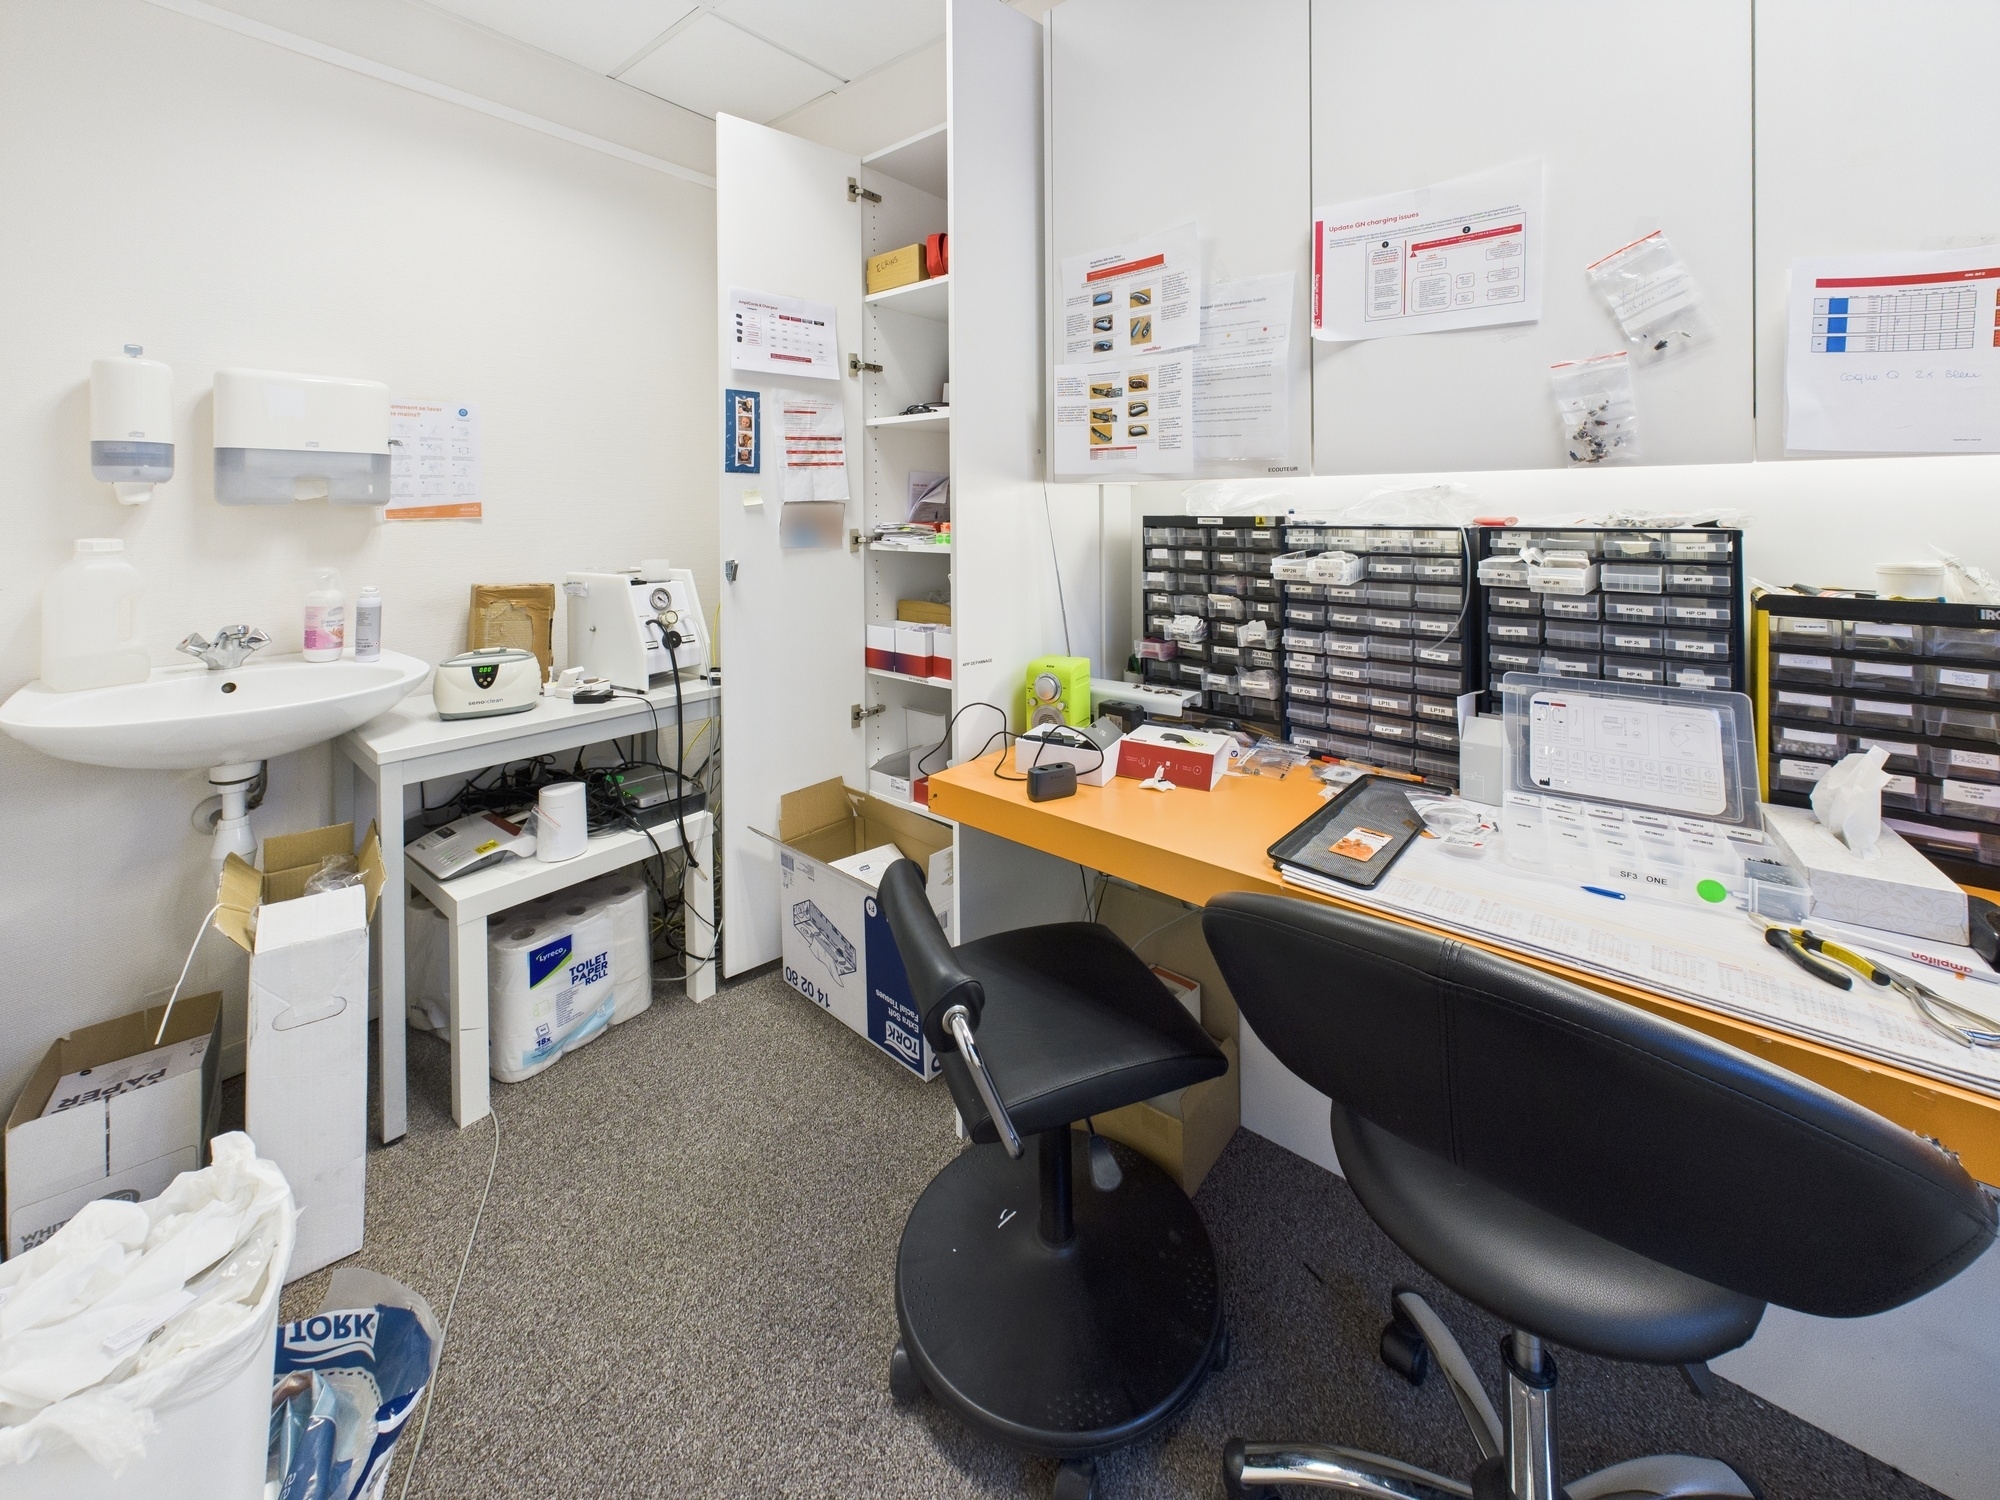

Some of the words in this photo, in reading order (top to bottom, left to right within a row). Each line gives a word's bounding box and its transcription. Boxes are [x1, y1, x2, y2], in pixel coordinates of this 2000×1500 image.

[1328, 224, 1354, 233] Update
[1366, 215, 1398, 227] charging
[1398, 212, 1420, 221] issues
[1620, 870, 1638, 880] SF3
[1646, 876, 1668, 886] ONE
[539, 947, 563, 962] Lyreco
[569, 951, 608, 976] TOILET
[1911, 952, 1973, 973] amplifon
[572, 961, 608, 985] PAPER
[585, 969, 608, 986] ROLL
[785, 966, 798, 982] 80
[800, 976, 814, 997] 02
[816, 987, 831, 1008] 14
[875, 988, 899, 1010] Tissues
[888, 1006, 901, 1023] Soft
[900, 1004, 919, 1022] Facial
[902, 1016, 919, 1033] Extra
[887, 1024, 918, 1055] TORK
[58, 1068, 167, 1109] PAPER
